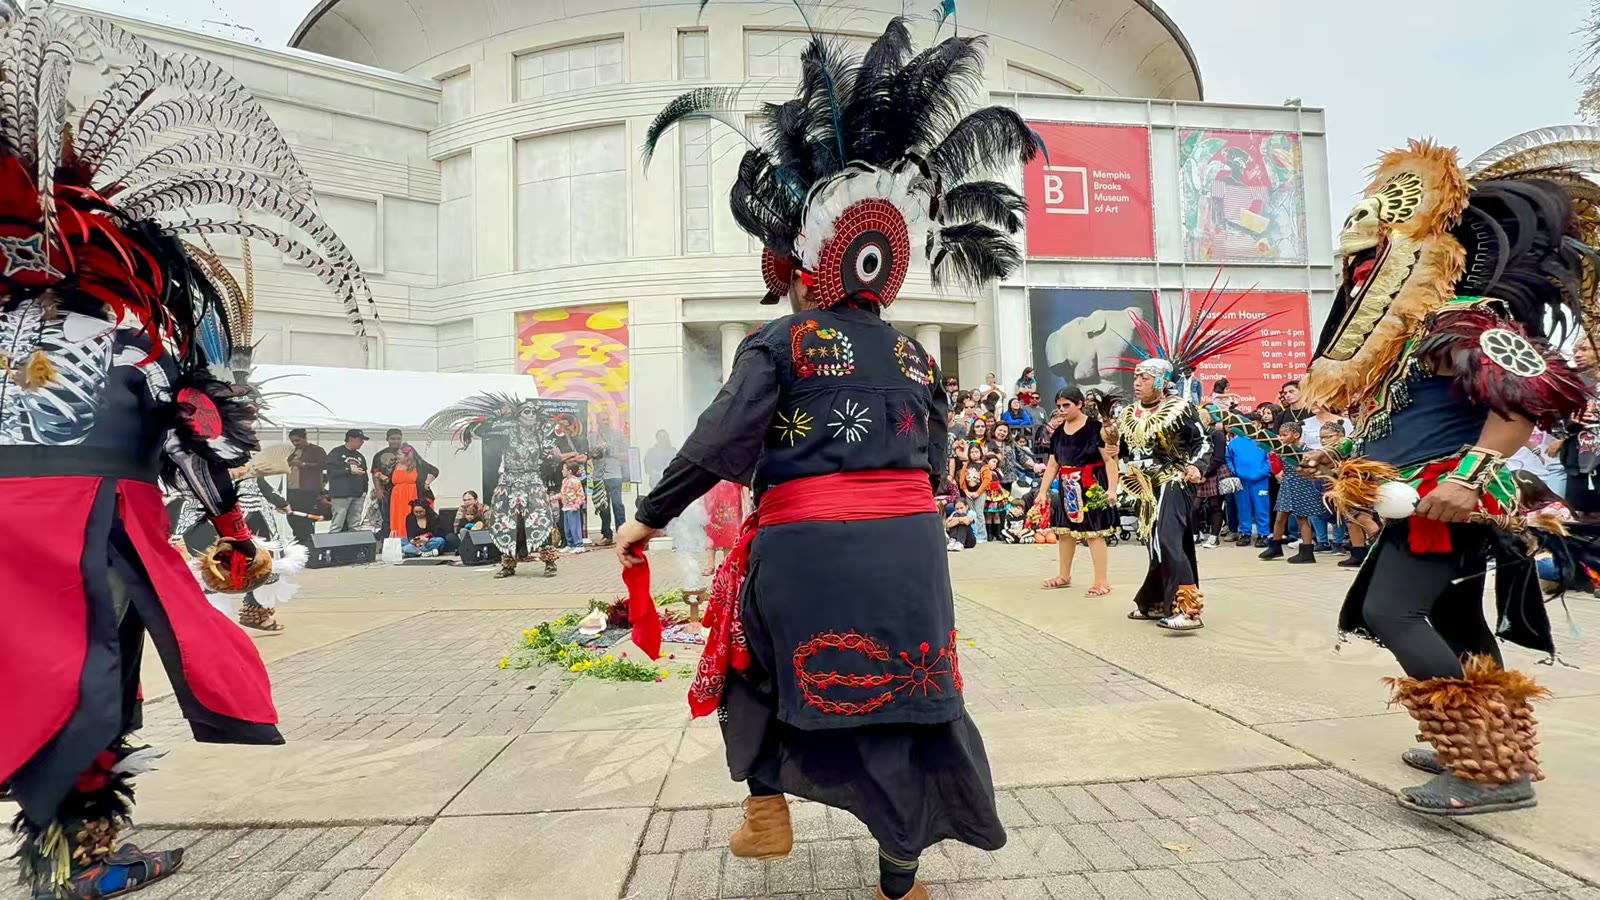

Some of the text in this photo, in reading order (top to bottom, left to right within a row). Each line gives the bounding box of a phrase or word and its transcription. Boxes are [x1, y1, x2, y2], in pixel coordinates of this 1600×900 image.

[1093, 170, 1131, 180] Memphis
[1043, 174, 1064, 204] B
[1093, 182, 1122, 191] Brooks
[1094, 193, 1130, 202] Museum
[1095, 205, 1119, 213] of Art
[1239, 310, 1267, 320] Hours
[1199, 362, 1232, 370] Saturday
